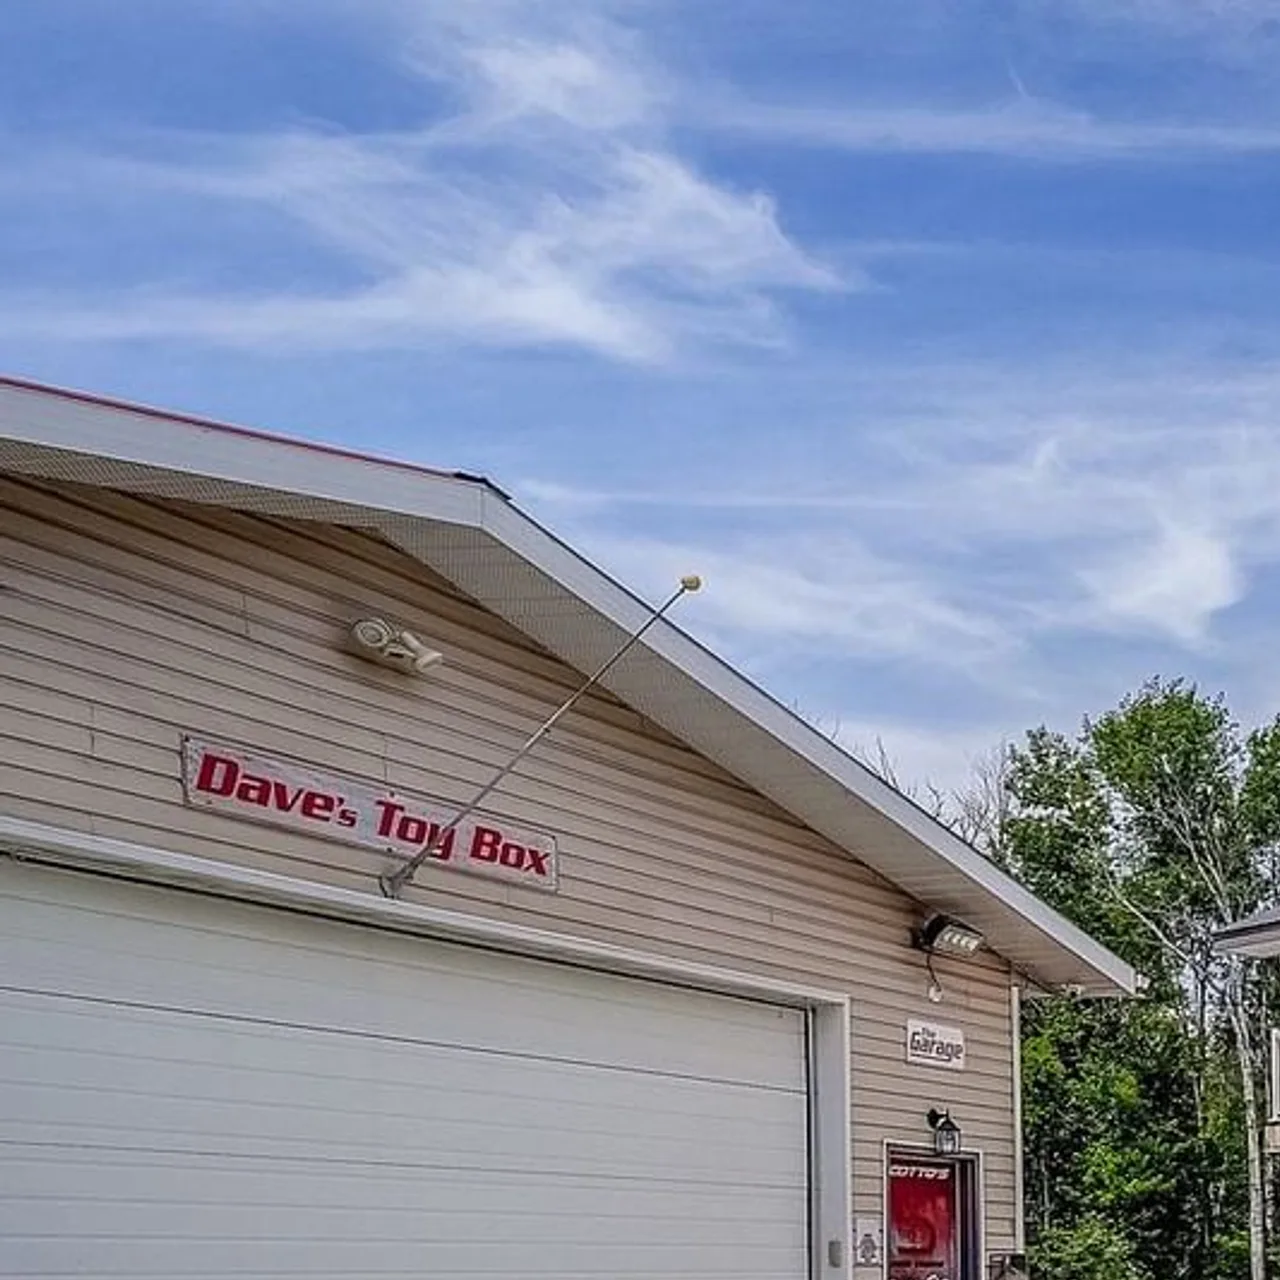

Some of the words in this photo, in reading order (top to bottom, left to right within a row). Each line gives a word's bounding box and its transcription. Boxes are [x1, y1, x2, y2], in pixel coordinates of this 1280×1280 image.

[196, 753, 358, 828] Dave's
[375, 800, 455, 861] Toy
[469, 825, 550, 876] Box
[910, 1031, 963, 1062] Garage
